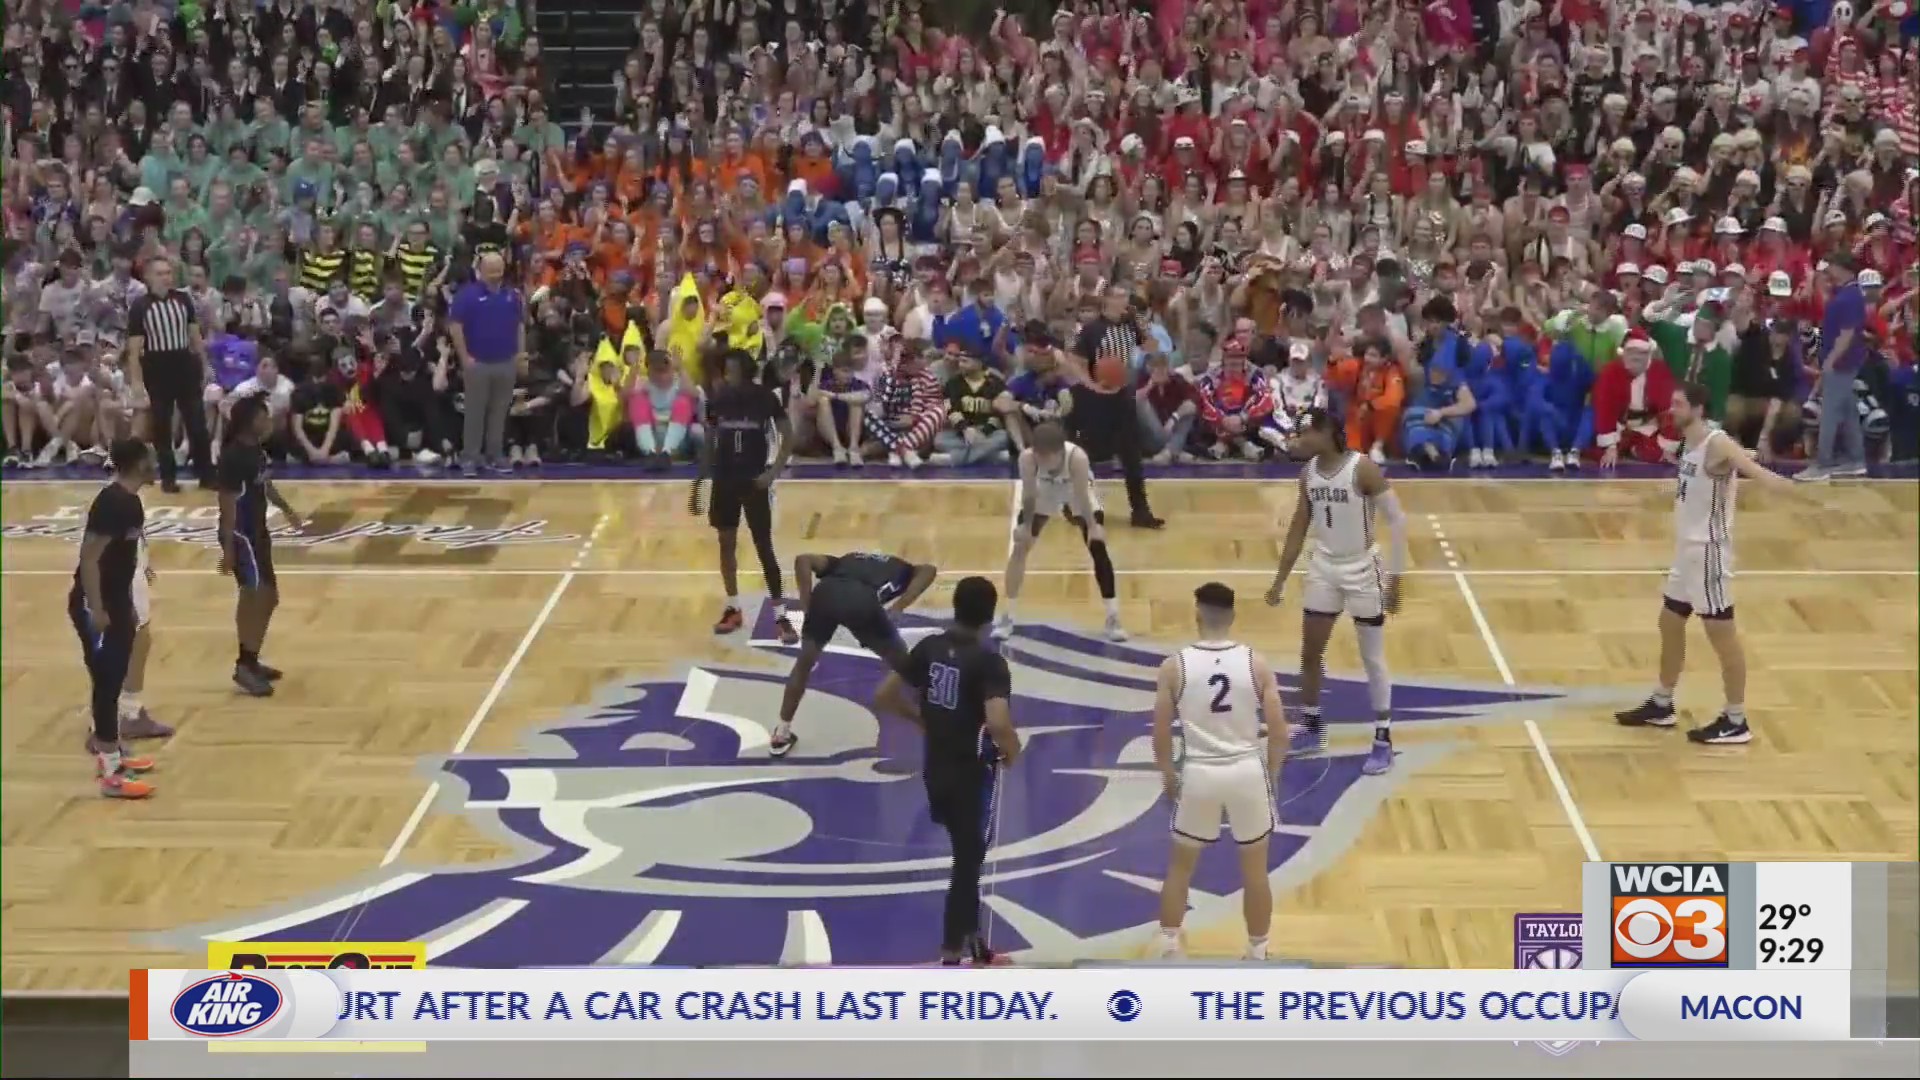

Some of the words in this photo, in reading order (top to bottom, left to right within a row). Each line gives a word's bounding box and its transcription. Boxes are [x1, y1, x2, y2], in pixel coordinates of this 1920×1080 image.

[1325, 505, 1333, 528] 1
[927, 661, 960, 710] 30
[1207, 672, 1232, 713] 2
